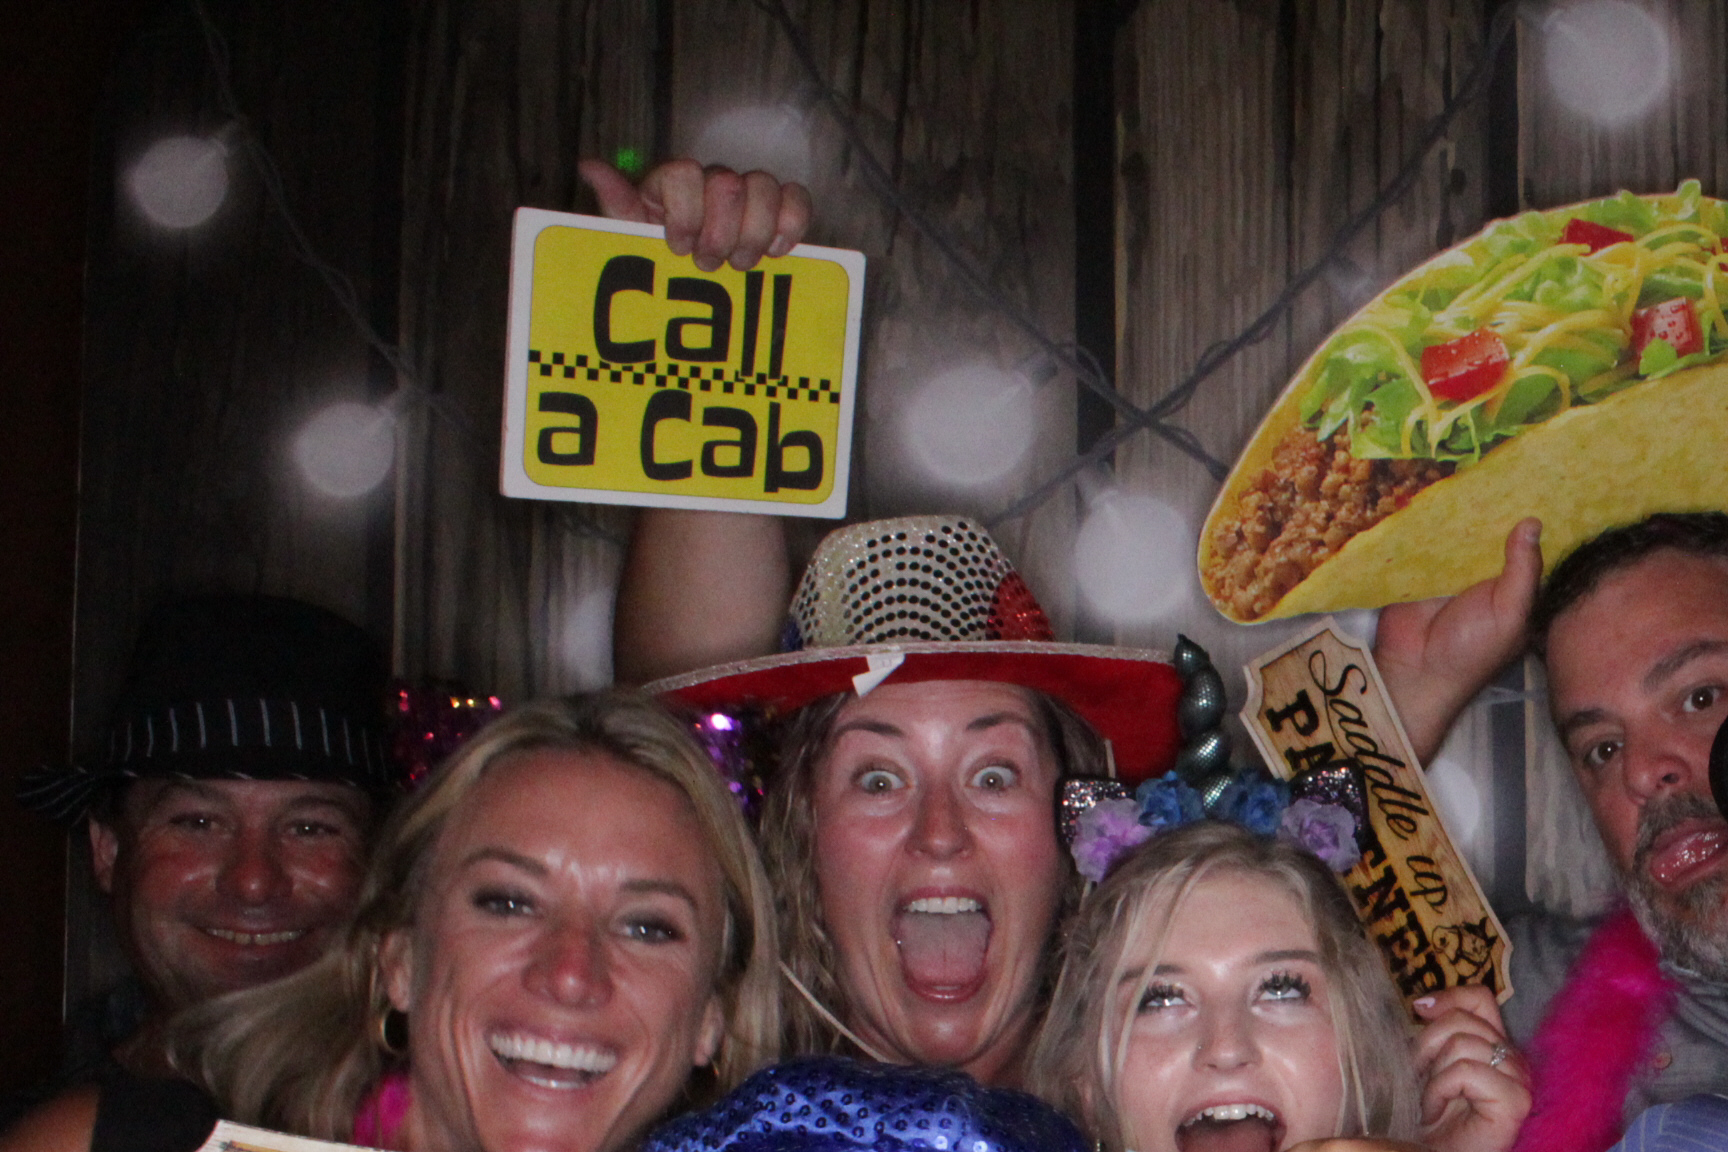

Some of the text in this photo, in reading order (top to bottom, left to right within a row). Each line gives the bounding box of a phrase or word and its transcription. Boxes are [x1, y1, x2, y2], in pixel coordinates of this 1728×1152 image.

[593, 255, 792, 379] Call
[537, 388, 824, 493] a Cab
[1266, 689, 1447, 996] PANER
[1308, 650, 1448, 915] Saddle up
